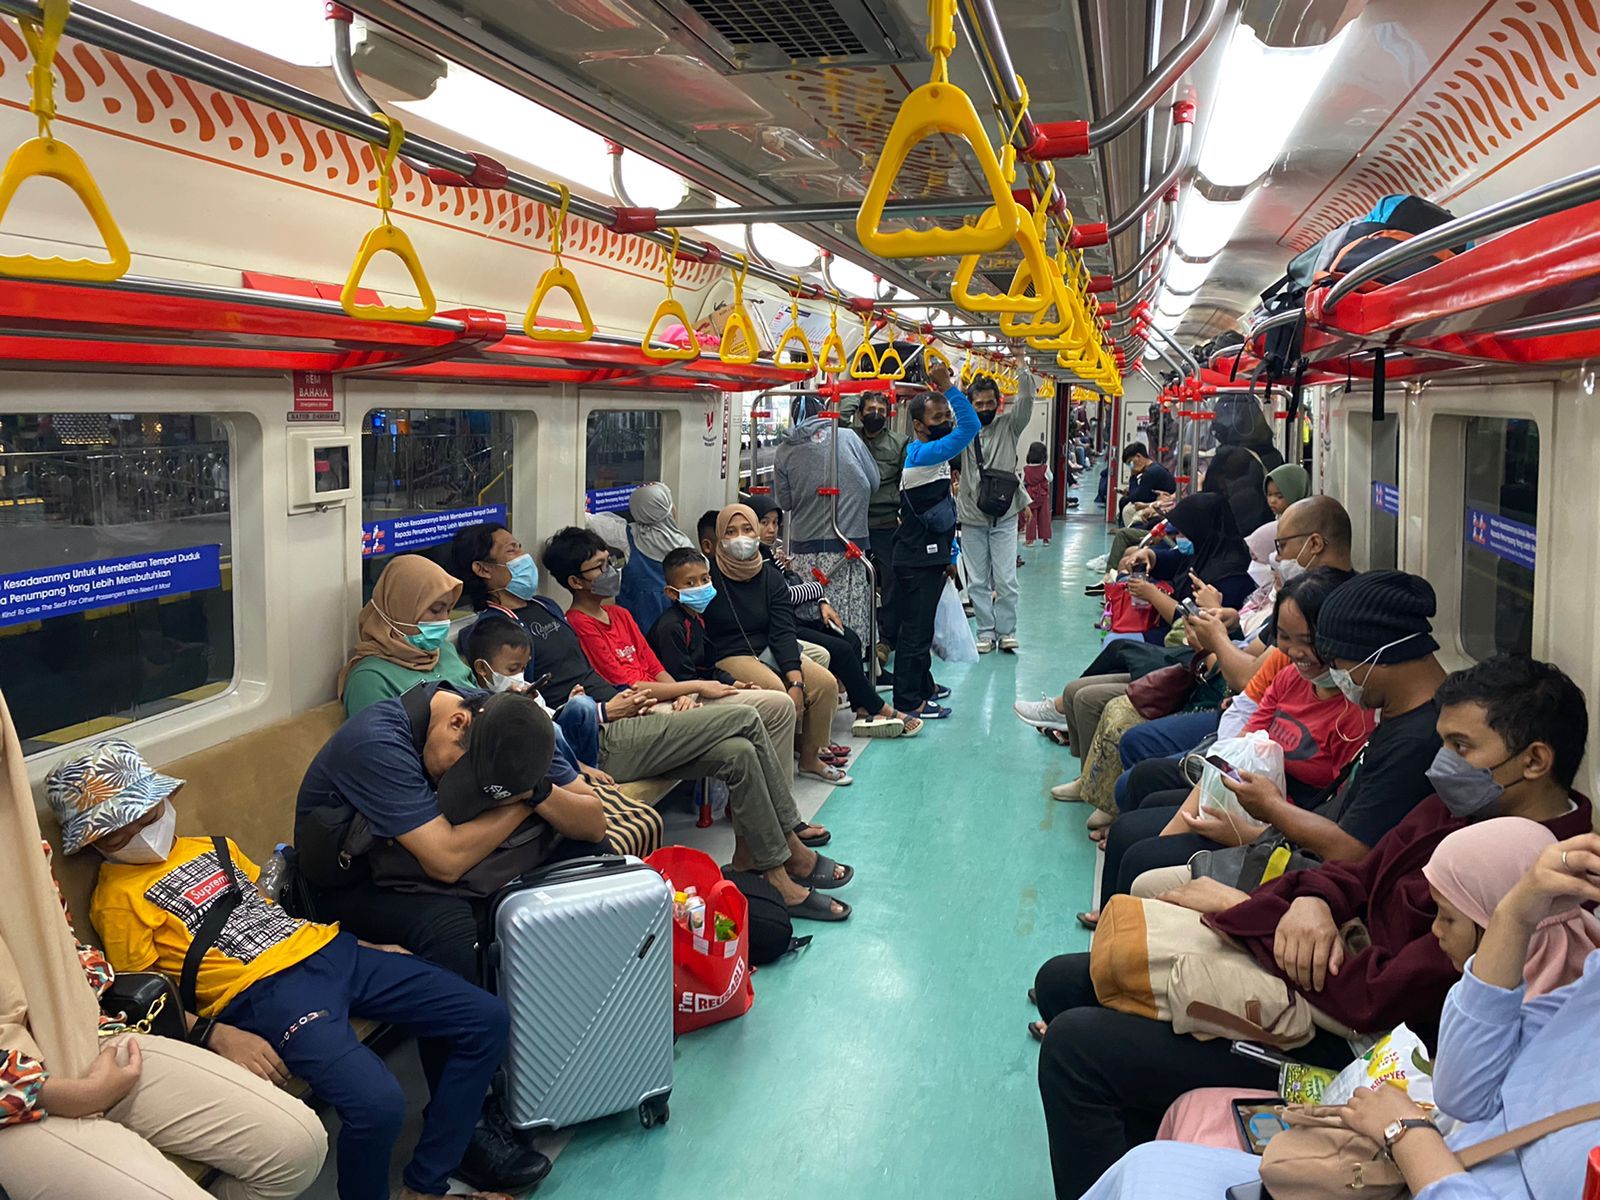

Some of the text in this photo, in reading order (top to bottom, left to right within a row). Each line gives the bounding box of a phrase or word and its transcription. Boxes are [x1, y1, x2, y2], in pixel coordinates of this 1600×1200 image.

[299, 387, 329, 397] BAHAYA
[3, 572, 71, 590] Kesadarannya
[72, 567, 97, 579] Untuk
[98, 560, 148, 575] Memberikan
[149, 555, 177, 566] Tempat
[178, 552, 201, 562] Duduk
[9, 587, 67, 604] Penumpang
[68, 582, 90, 593] Yang
[92, 577, 115, 589] Lebih
[116, 569, 172, 585] Membutuhkan
[2, 609, 16, 618] Kind
[25, 606, 40, 614] Give
[53, 601, 68, 609] Seat
[78, 595, 95, 604] Other
[95, 590, 126, 600] Passengers
[139, 585, 154, 593] Need
[158, 582, 171, 590] Most
[191, 874, 229, 900] Suprem
[698, 960, 744, 1011] REUSABLE
